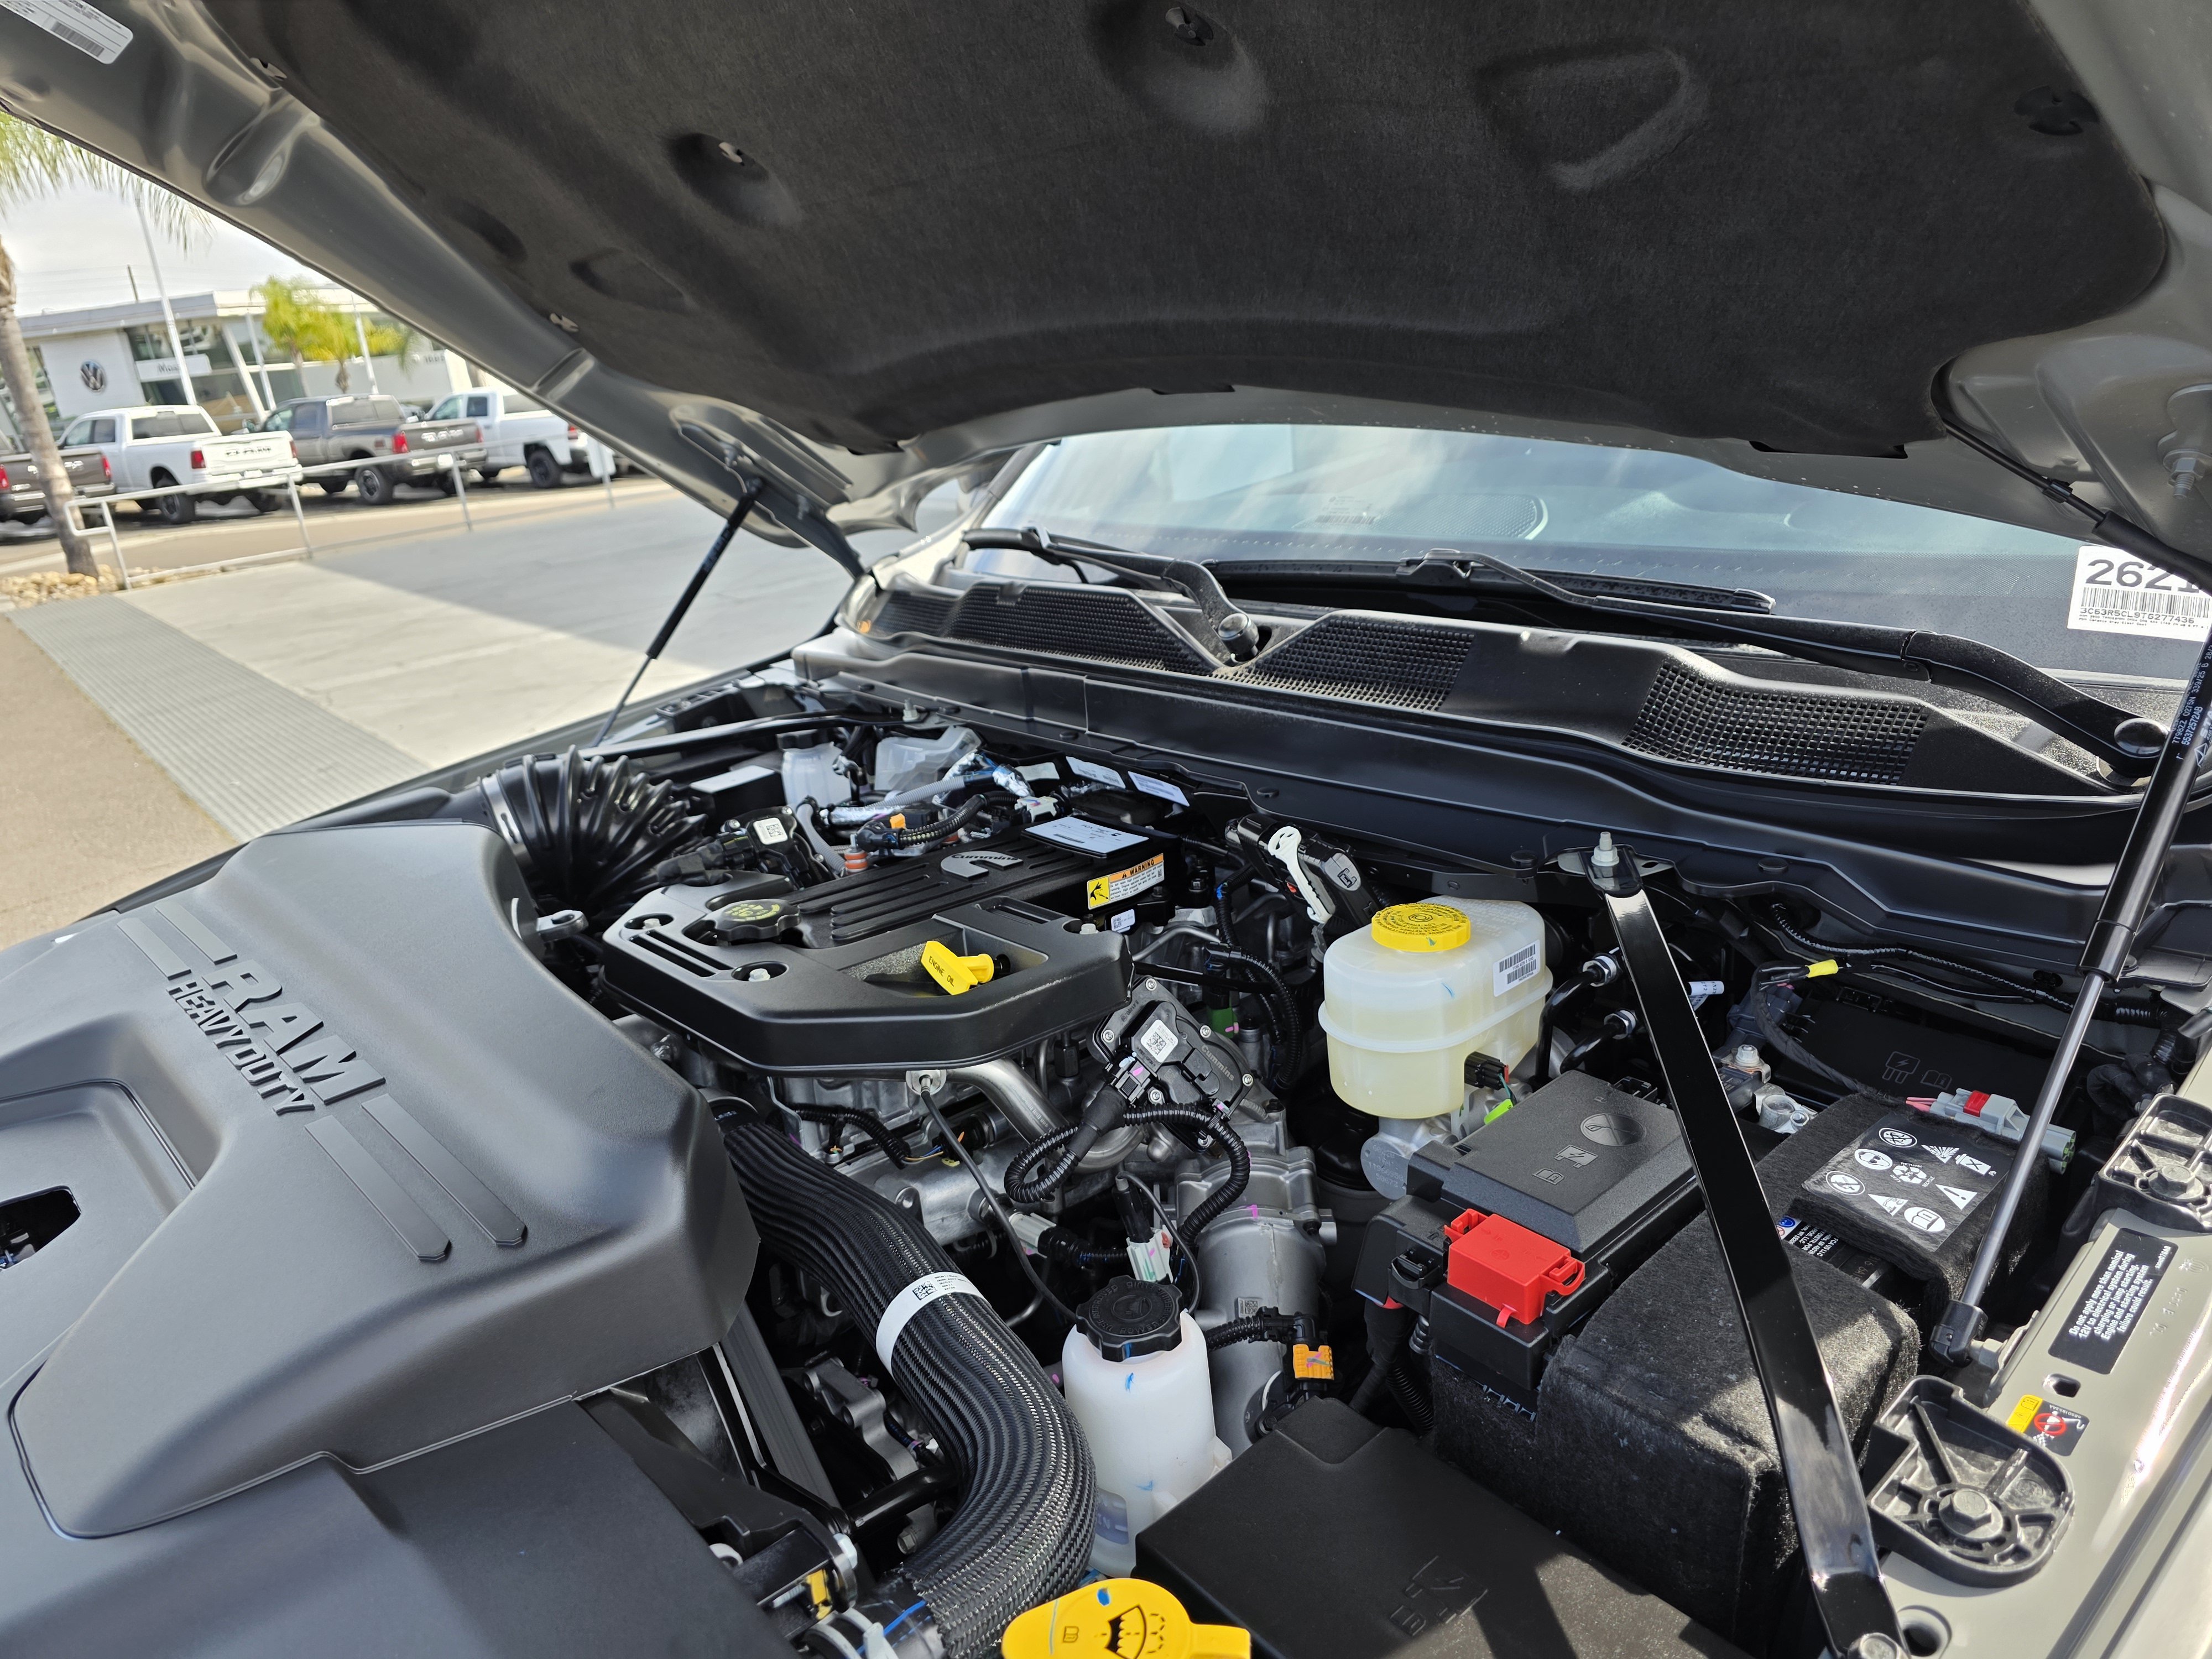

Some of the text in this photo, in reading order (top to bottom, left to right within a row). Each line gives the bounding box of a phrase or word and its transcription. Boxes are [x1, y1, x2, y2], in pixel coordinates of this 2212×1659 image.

[2180, 705, 2203, 746] 55372572AB
[1129, 859, 1155, 876] WARNING
[928, 956, 945, 977] ENGINE
[201, 959, 387, 1106] RAM
[1201, 1045, 1235, 1081] Cummins
[2069, 1250, 2124, 1335] Do not apply more than nominal
[2079, 1253, 2136, 1338] 12V to electrical system during
[2094, 1264, 2140, 1334] charging or jump starting.
[2100, 1265, 2150, 1339] Engine and starting system
[2116, 1279, 2153, 1332] failure could result.
[1119, 1321, 1160, 1334] POWER
